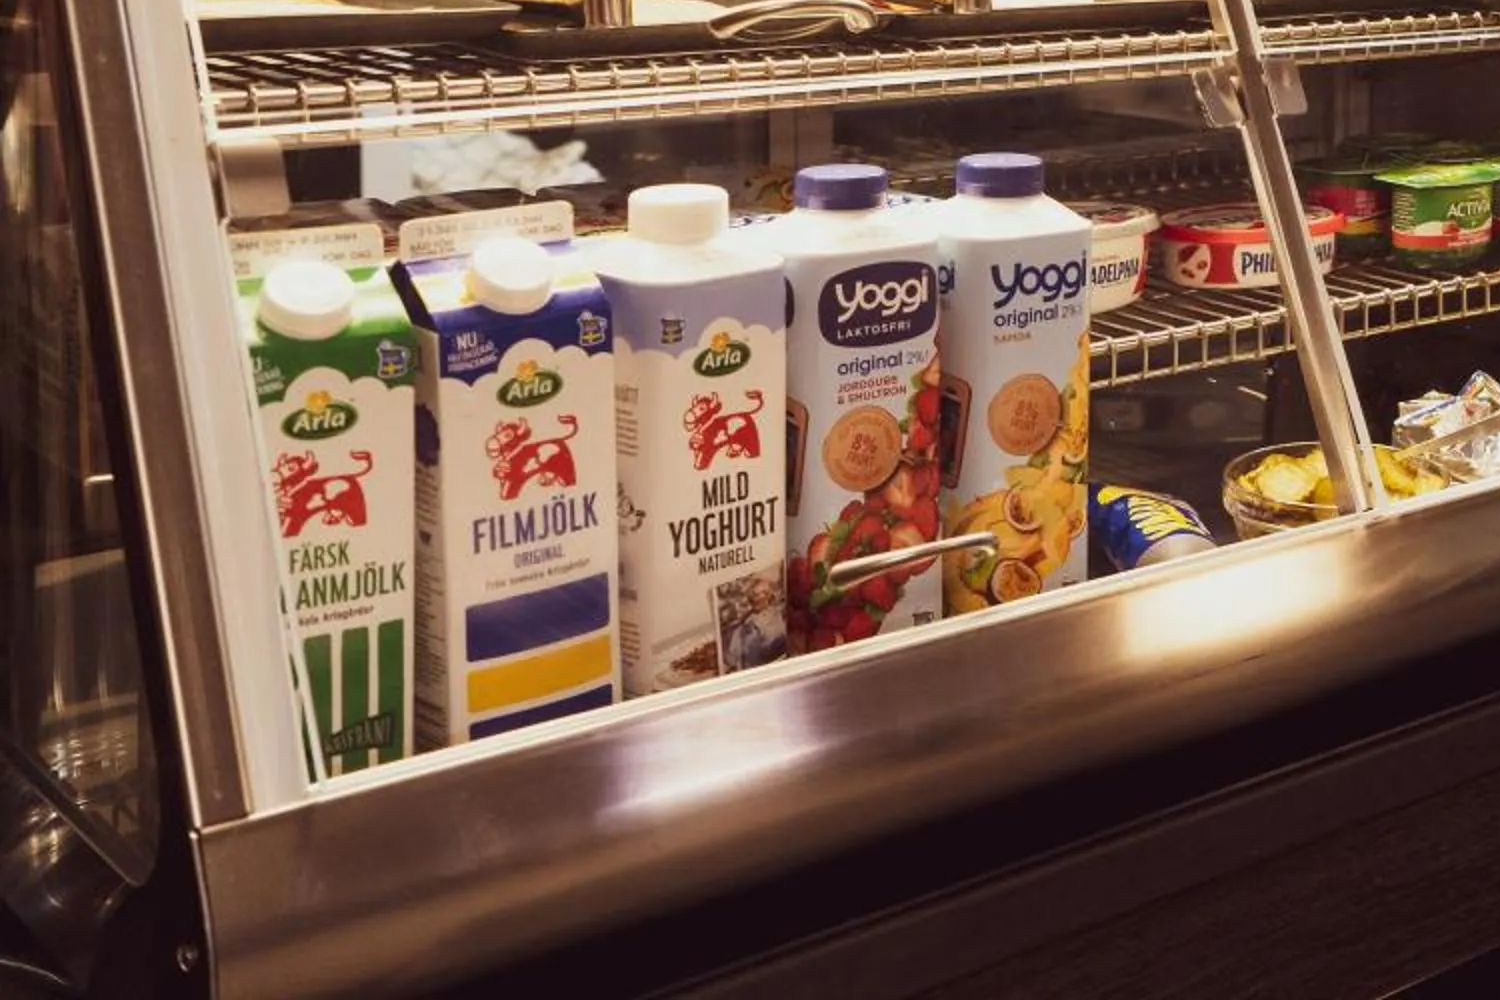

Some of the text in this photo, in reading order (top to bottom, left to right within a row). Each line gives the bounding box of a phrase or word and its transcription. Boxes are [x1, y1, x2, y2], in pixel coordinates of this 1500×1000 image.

[835, 267, 929, 324] yoggi
[991, 249, 1087, 310] yoggi
[837, 320, 911, 341] LAKTOSFRI
[993, 304, 1059, 329] original
[701, 347, 742, 371] Arla
[837, 350, 903, 376] original
[507, 376, 554, 401] Arla
[292, 407, 347, 433] Arla
[702, 470, 750, 510] MILD
[472, 491, 599, 555] FILMJÖLK
[668, 496, 779, 559] YOGHURT
[289, 540, 351, 575] FÄRSK
[698, 545, 756, 576] NATURELL
[294, 560, 406, 611] ANMJÖLK
